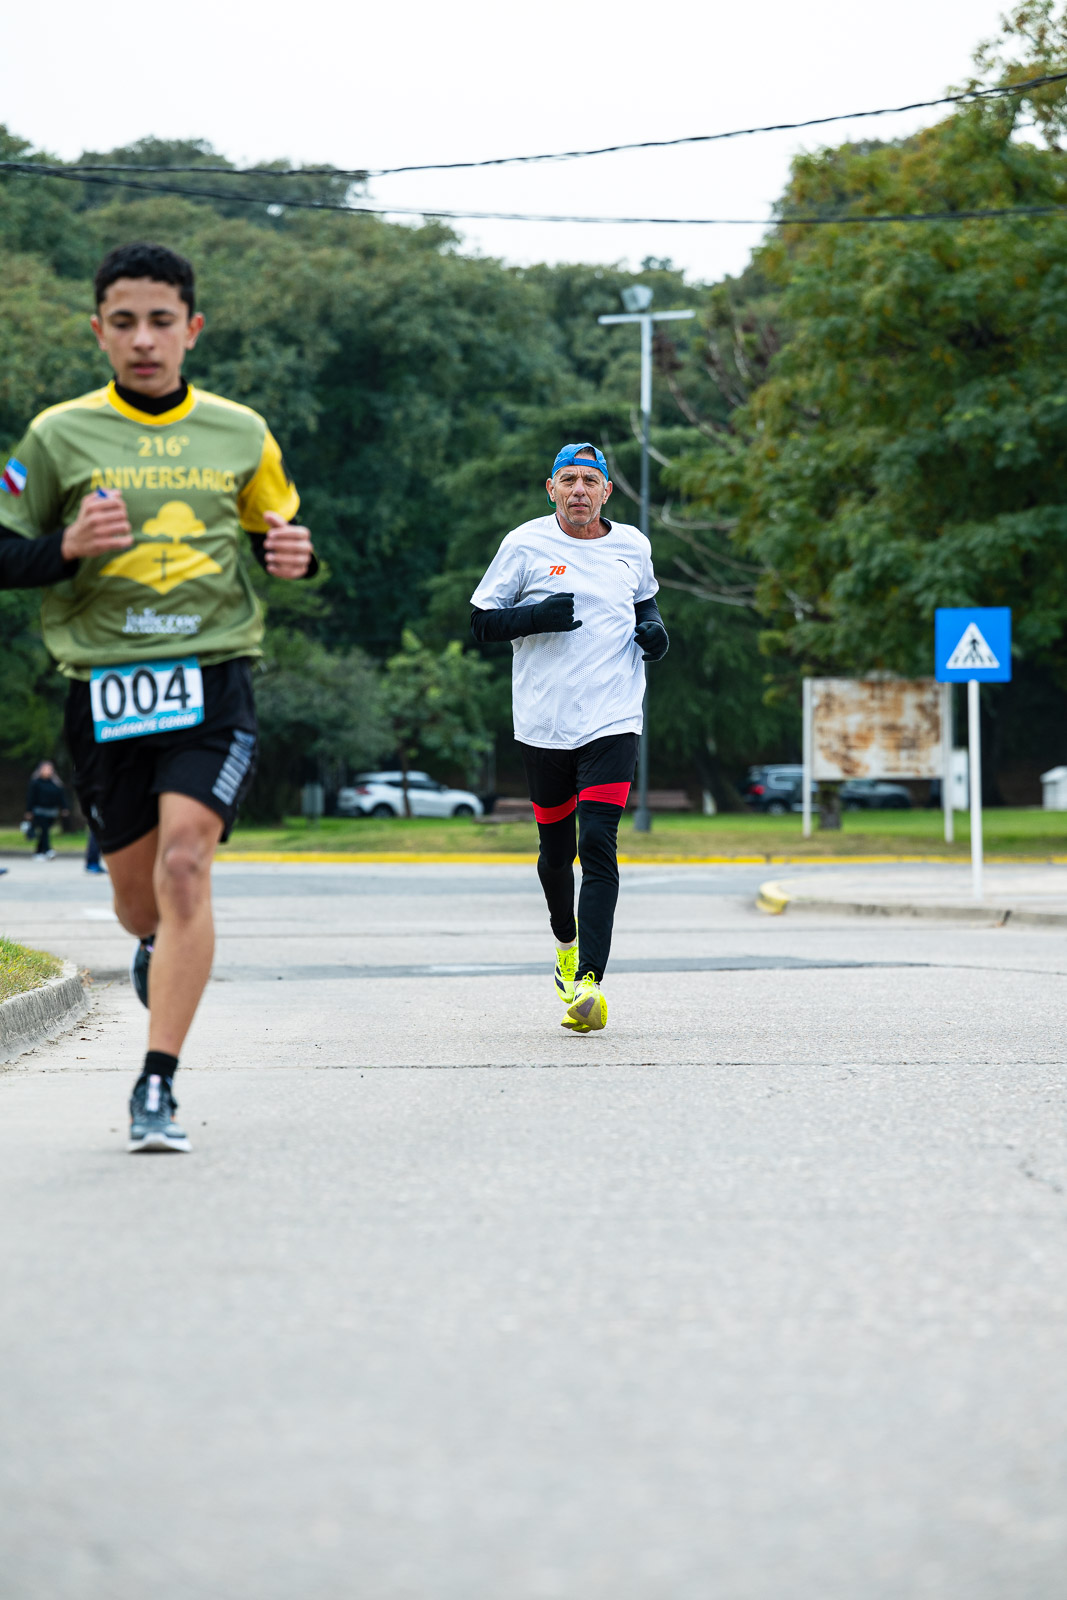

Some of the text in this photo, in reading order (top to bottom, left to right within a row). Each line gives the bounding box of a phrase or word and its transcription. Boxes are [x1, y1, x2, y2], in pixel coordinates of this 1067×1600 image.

[90, 465, 236, 493] ANIVERSARIO
[549, 565, 566, 576] 78
[101, 664, 192, 720] 004
